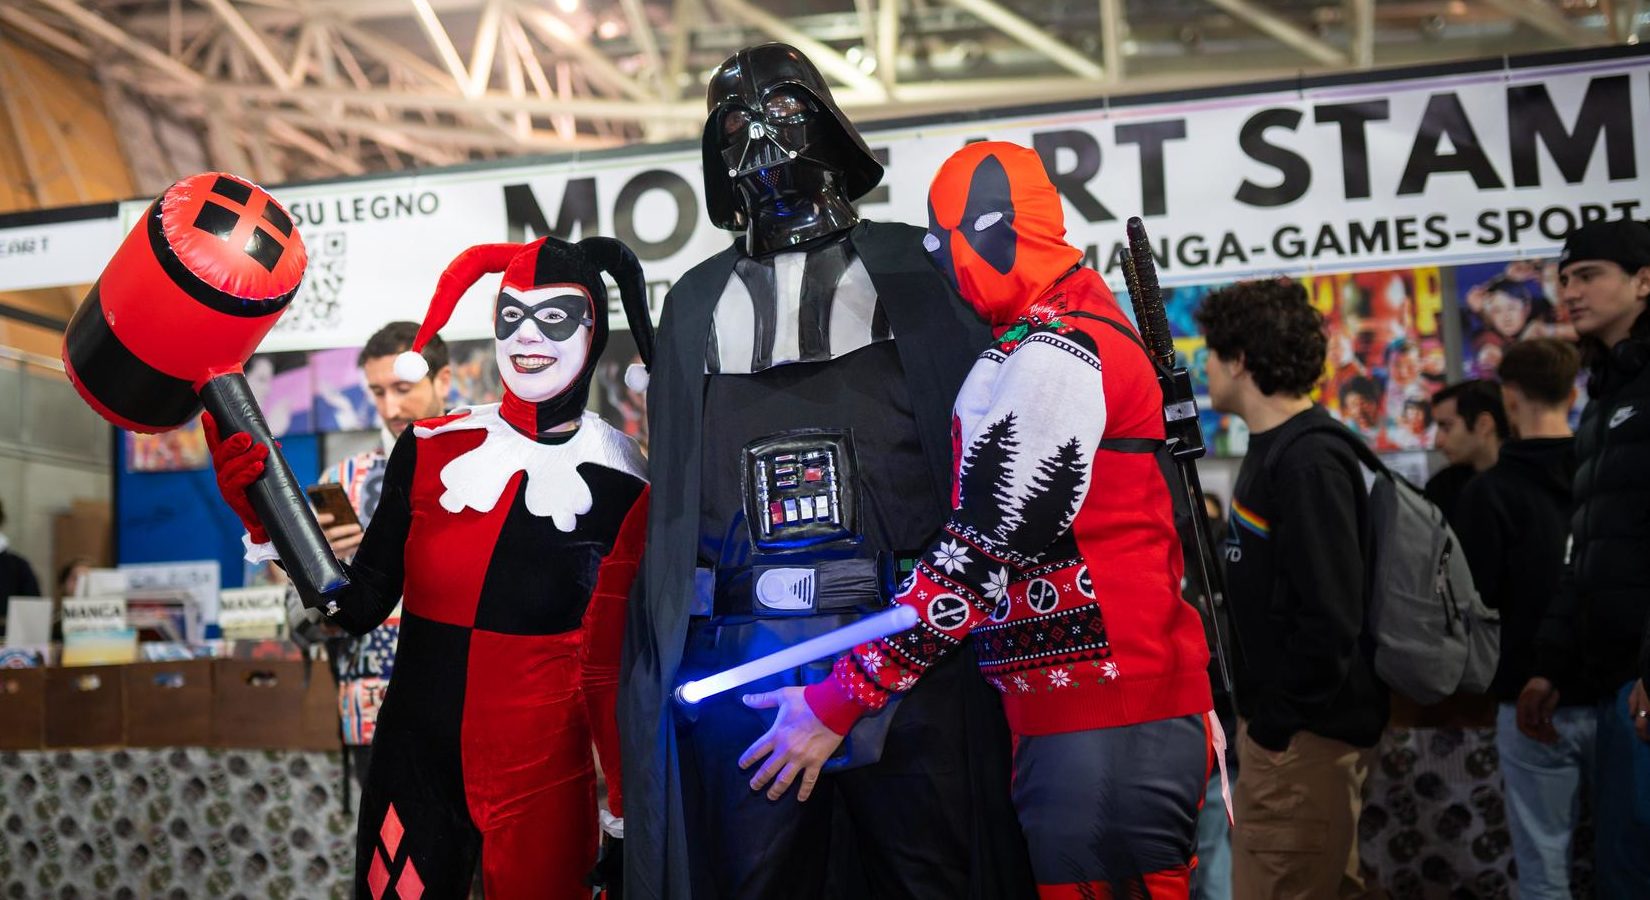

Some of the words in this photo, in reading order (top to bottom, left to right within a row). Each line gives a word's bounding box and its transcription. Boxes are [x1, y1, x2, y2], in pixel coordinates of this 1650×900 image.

[963, 118, 1187, 223] RT
[1234, 72, 1650, 208] STAM
[336, 192, 439, 223] LEGNO
[64, 603, 121, 619] MANGA
